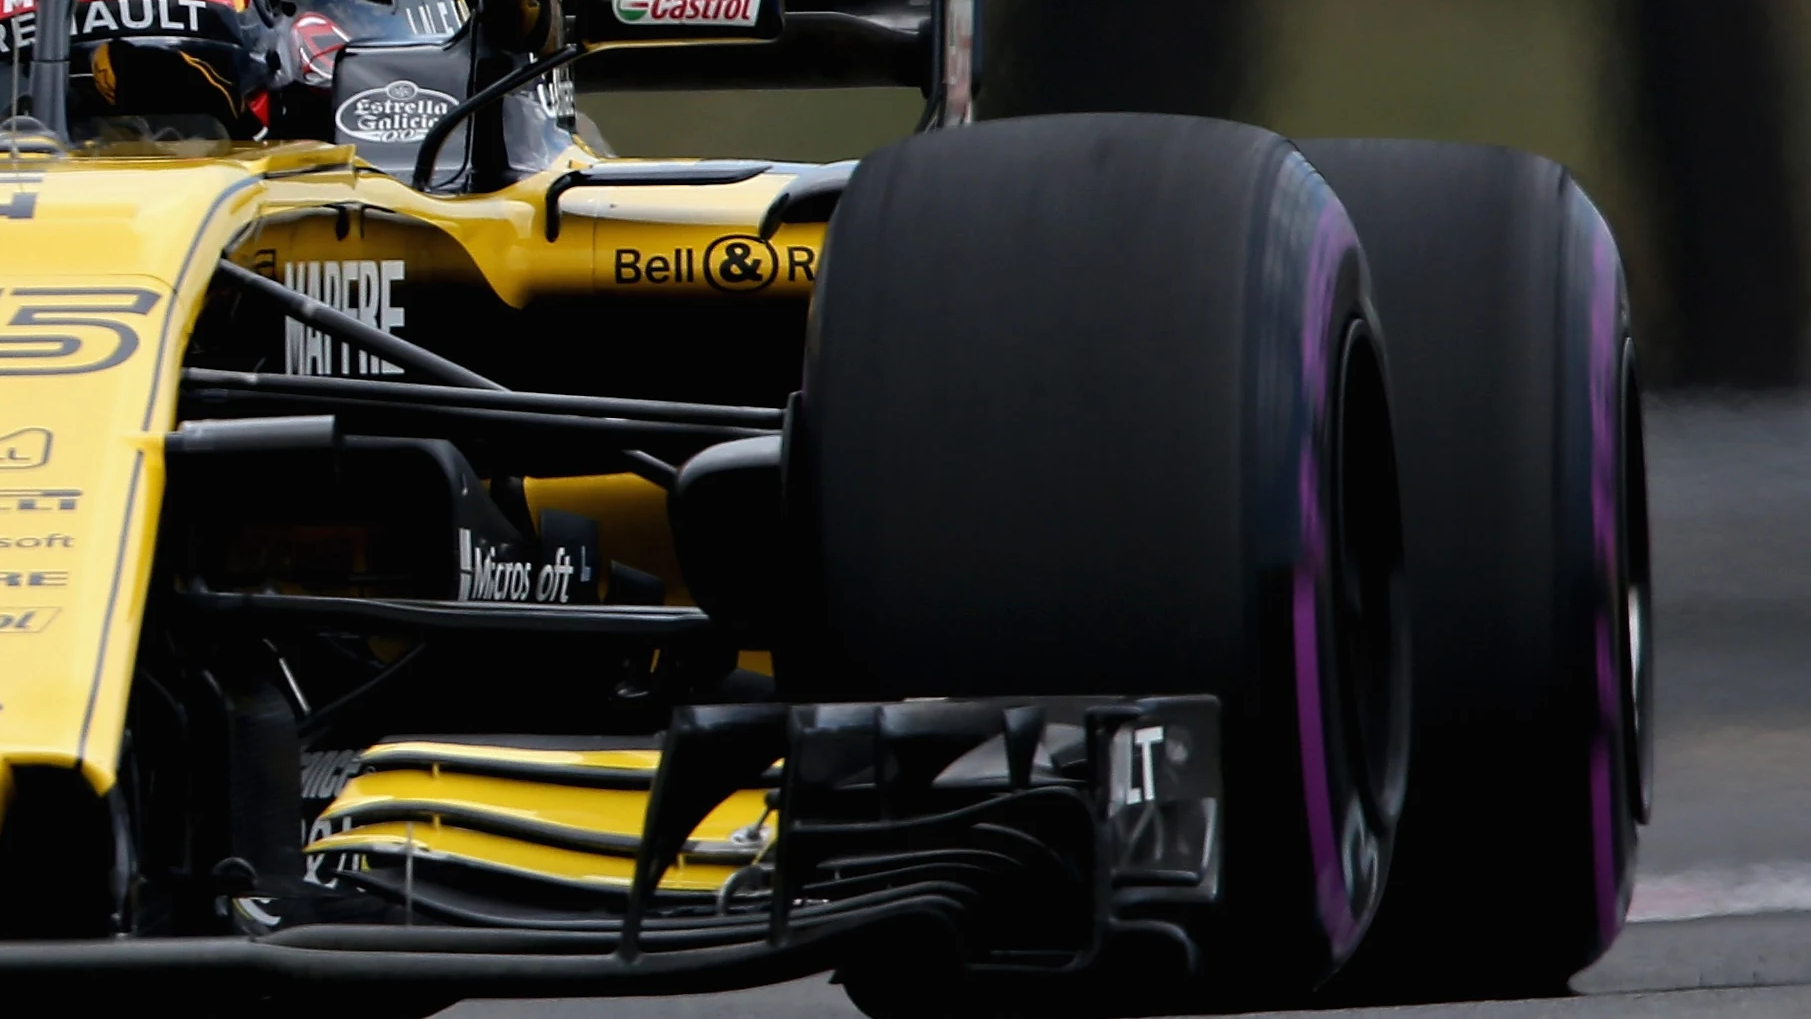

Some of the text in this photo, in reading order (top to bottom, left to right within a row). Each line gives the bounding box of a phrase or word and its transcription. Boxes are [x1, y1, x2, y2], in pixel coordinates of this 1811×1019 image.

[354, 98, 448, 115] Estrella
[615, 248, 694, 284] Bell
[284, 259, 406, 376] MAPFRE
